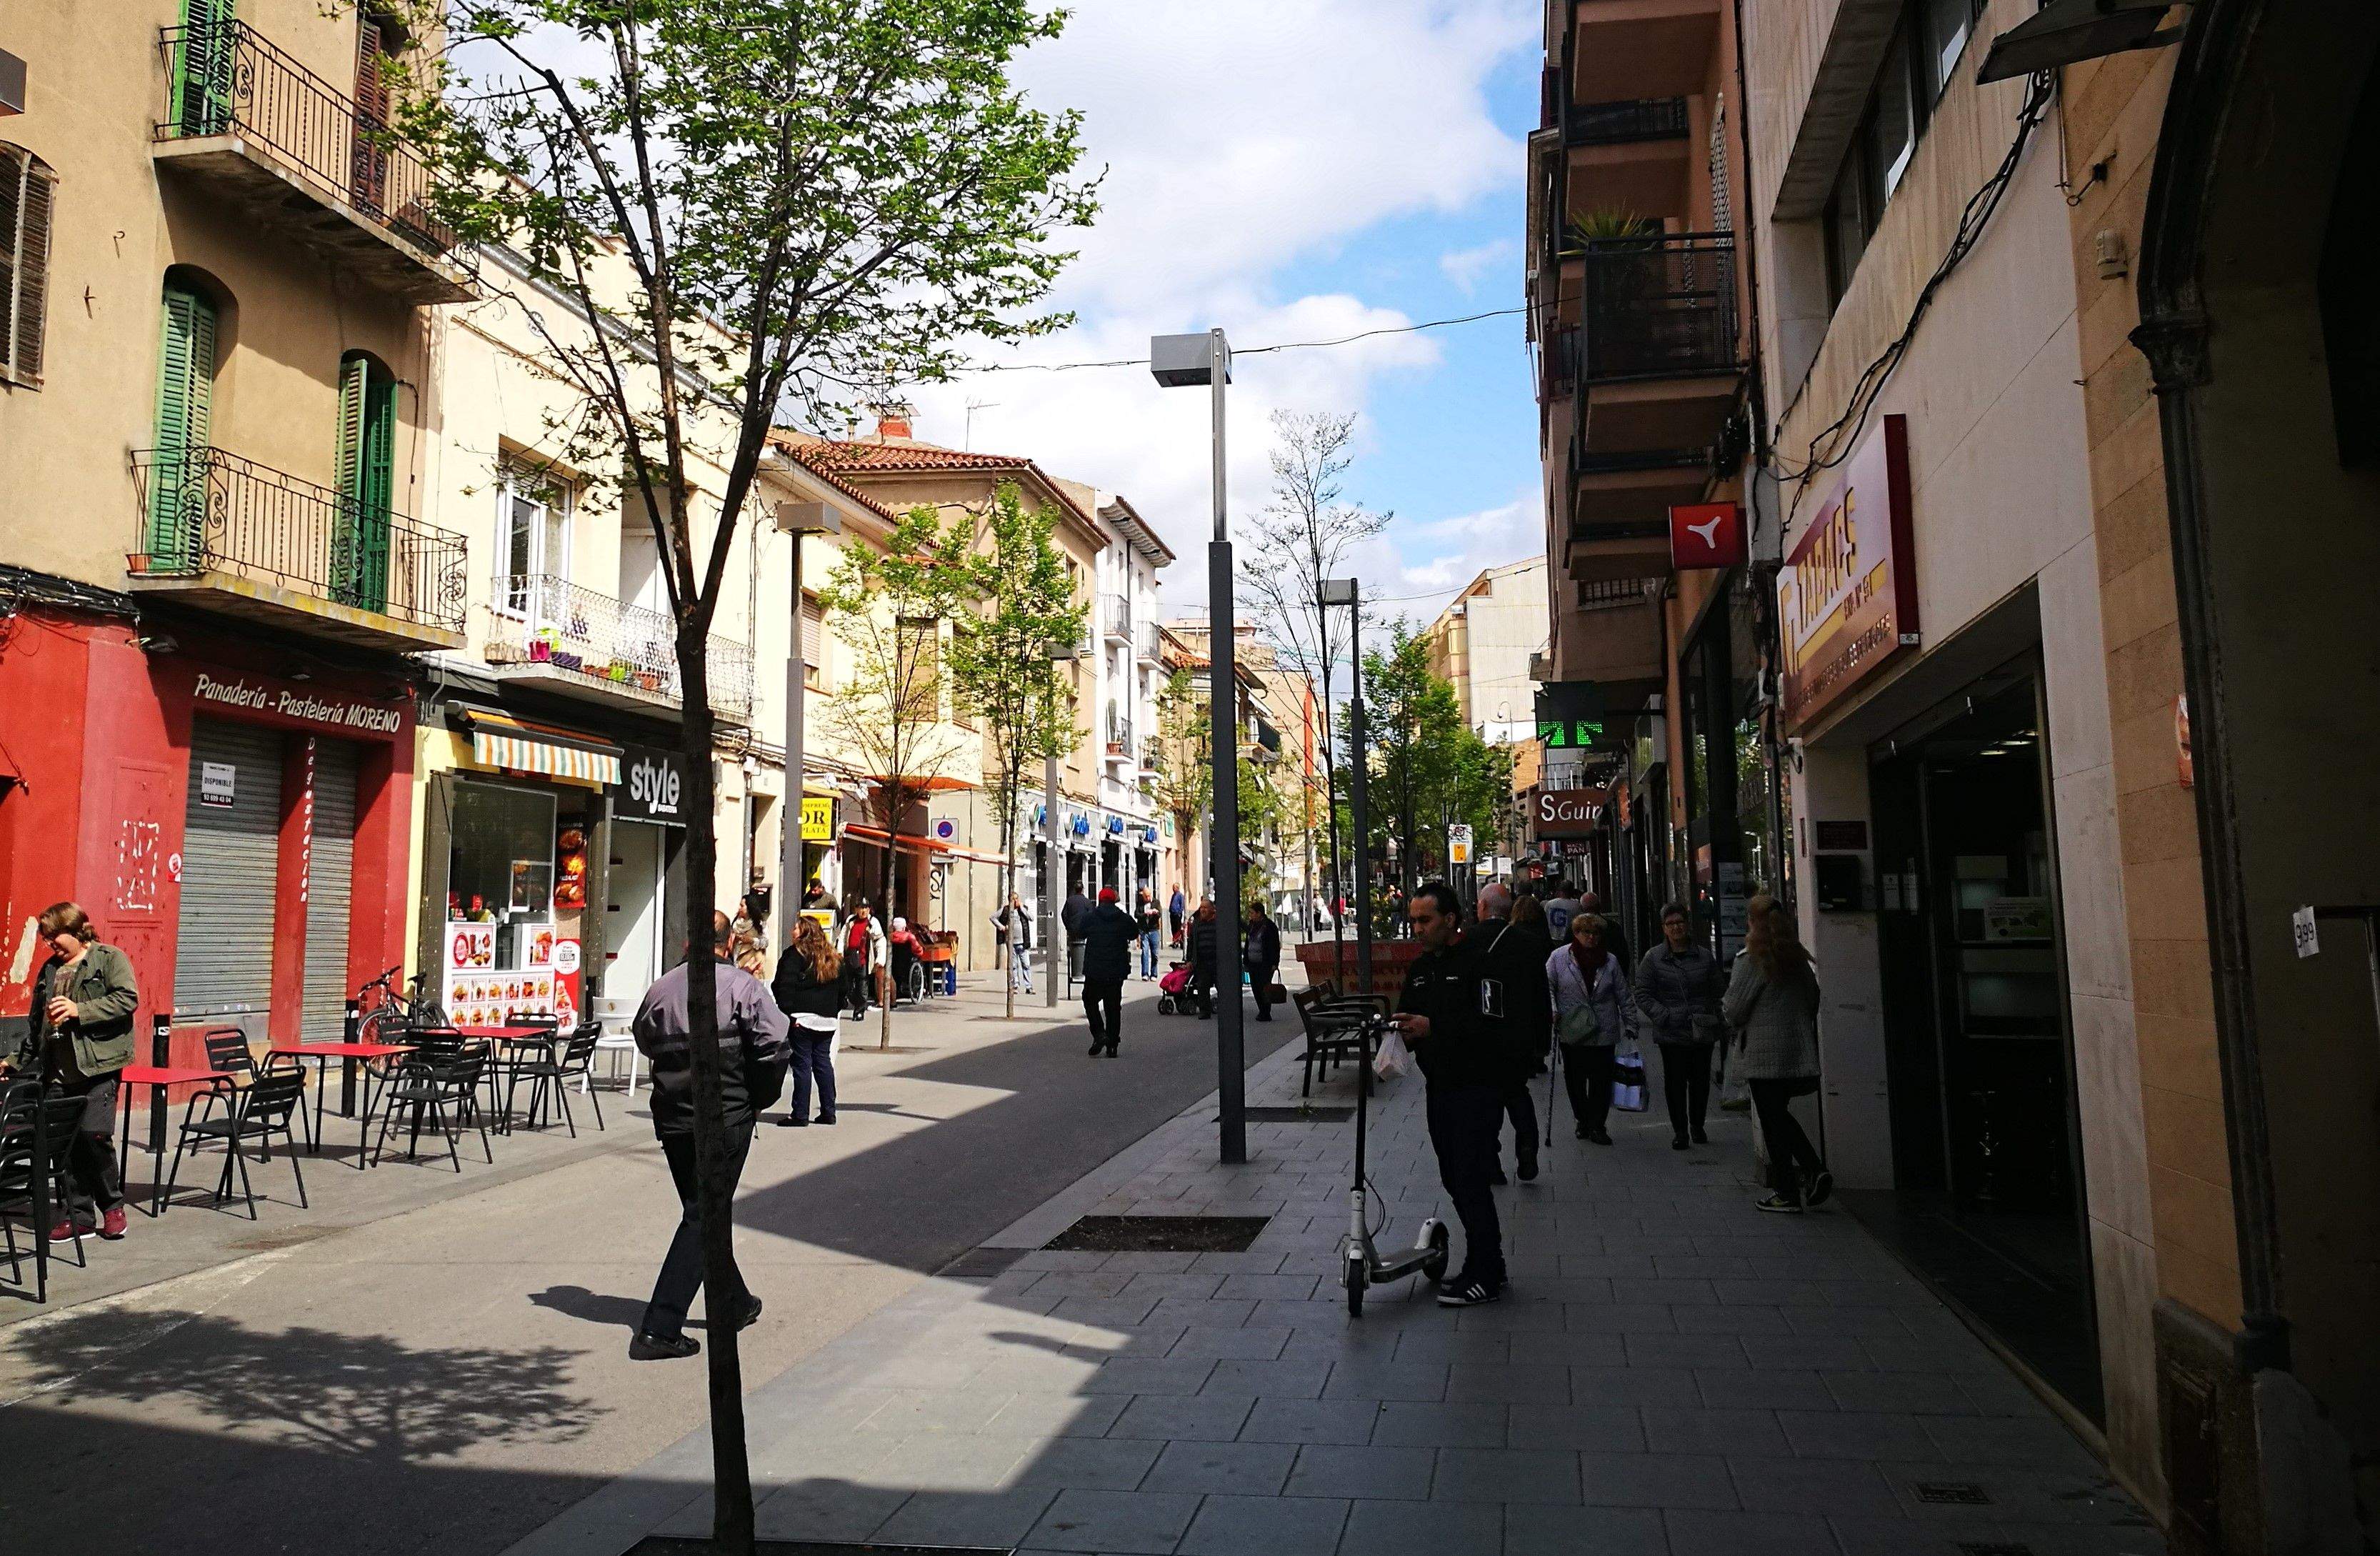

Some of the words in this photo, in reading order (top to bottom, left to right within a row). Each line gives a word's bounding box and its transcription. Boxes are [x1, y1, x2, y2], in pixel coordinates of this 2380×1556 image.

[1796, 487, 1857, 634] TABACS
[194, 674, 267, 709] Panadería
[277, 690, 344, 724] Pastelería
[344, 704, 401, 734] MORENO
[630, 757, 680, 814] style
